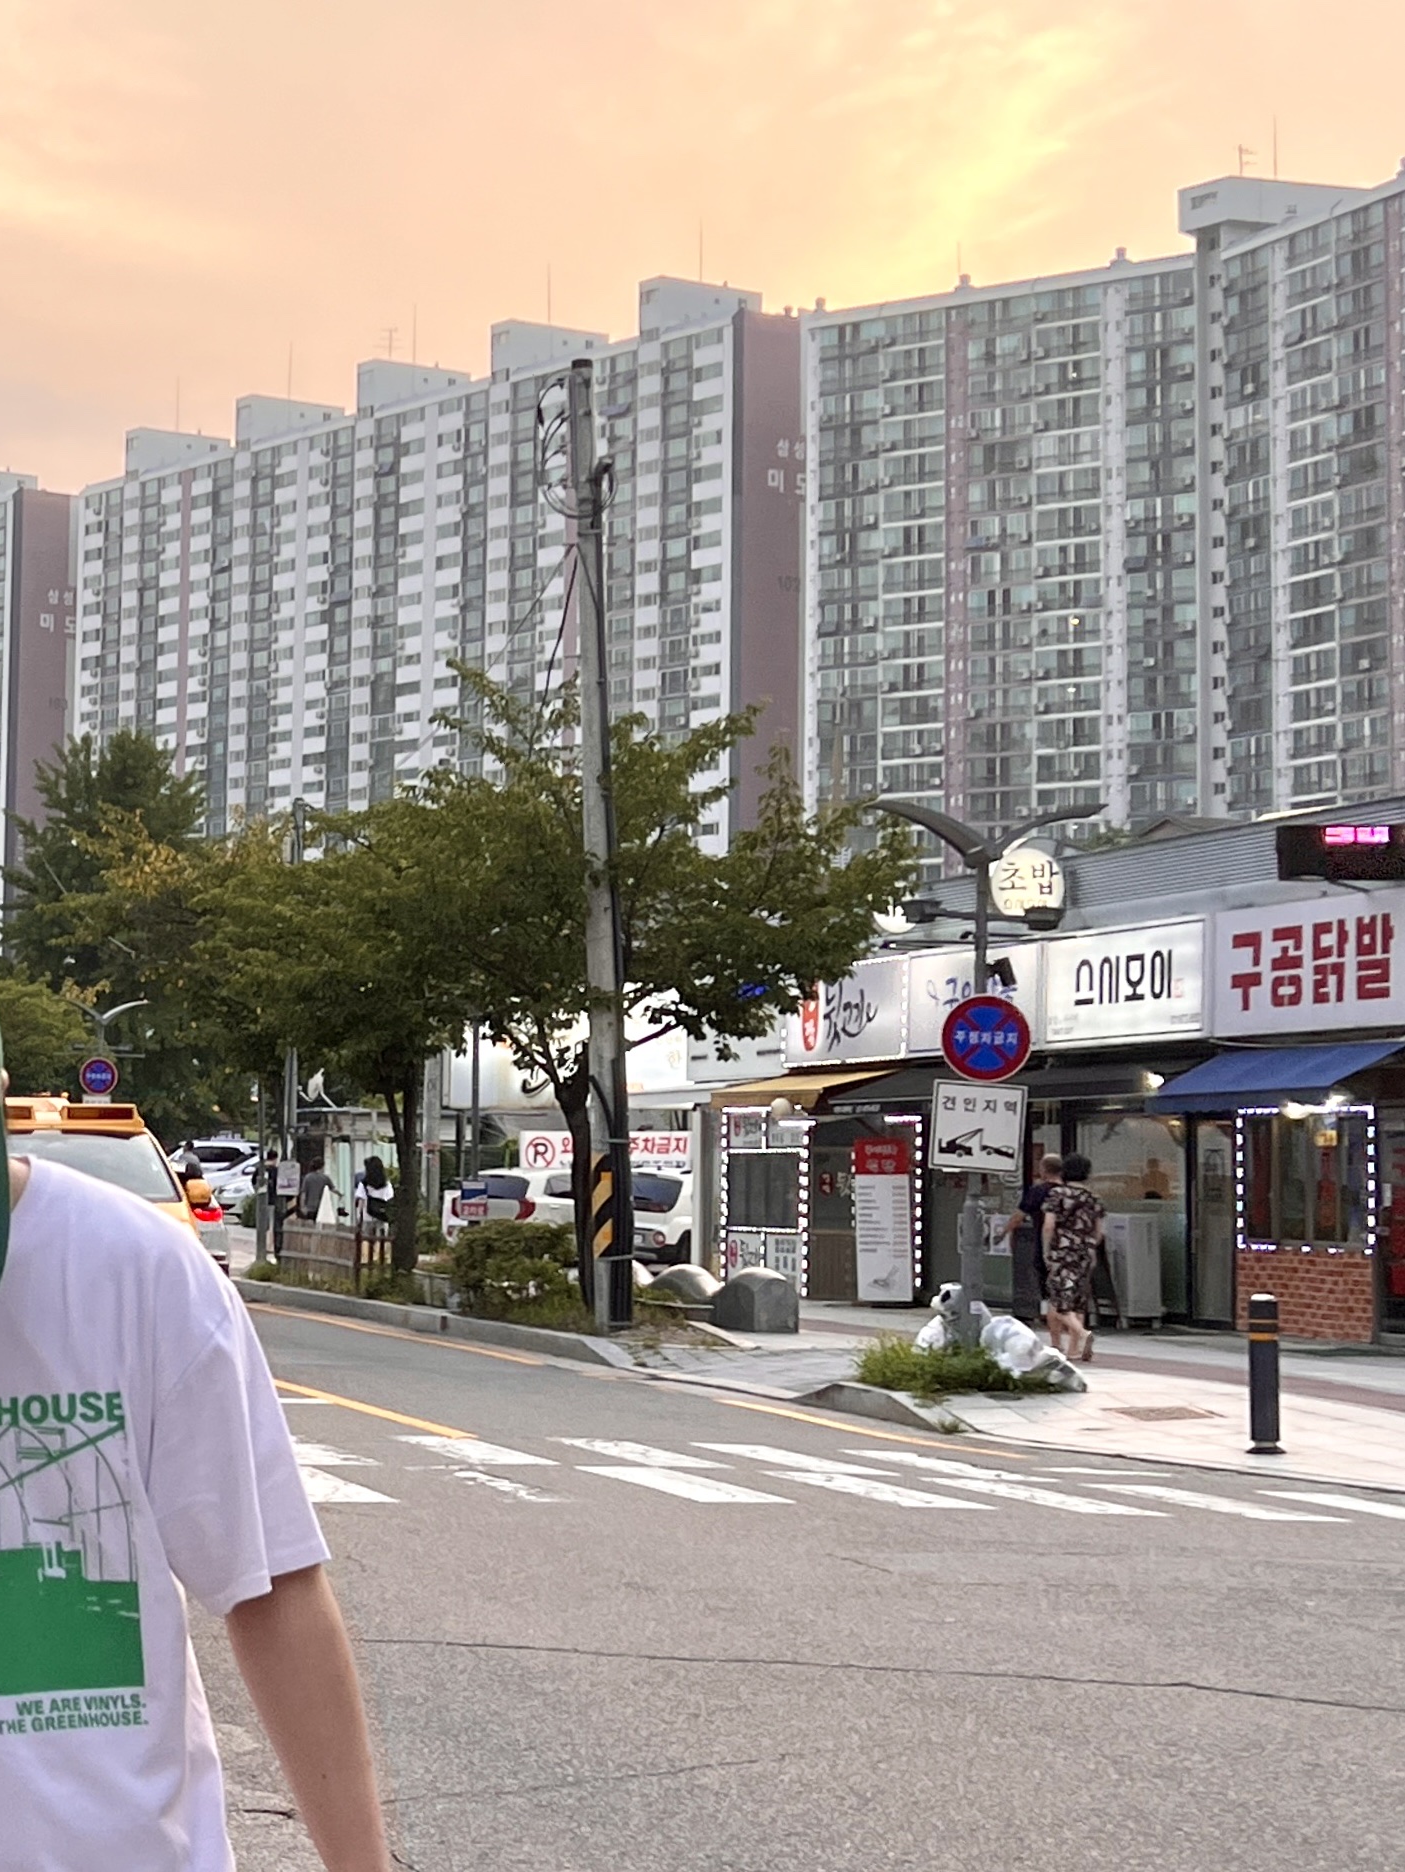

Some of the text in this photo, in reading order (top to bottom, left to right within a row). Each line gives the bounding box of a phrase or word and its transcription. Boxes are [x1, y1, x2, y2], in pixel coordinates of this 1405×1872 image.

[998, 860, 1060, 896] 초밥
[1230, 912, 1395, 1012] 구공닭발
[1074, 949, 1173, 1006] 스시모이
[953, 1030, 1019, 1045] 주정차금지
[15, 1693, 147, 1717] WE ARE VINYLS.
[30, 1710, 149, 1734] GREENHOUSE.
